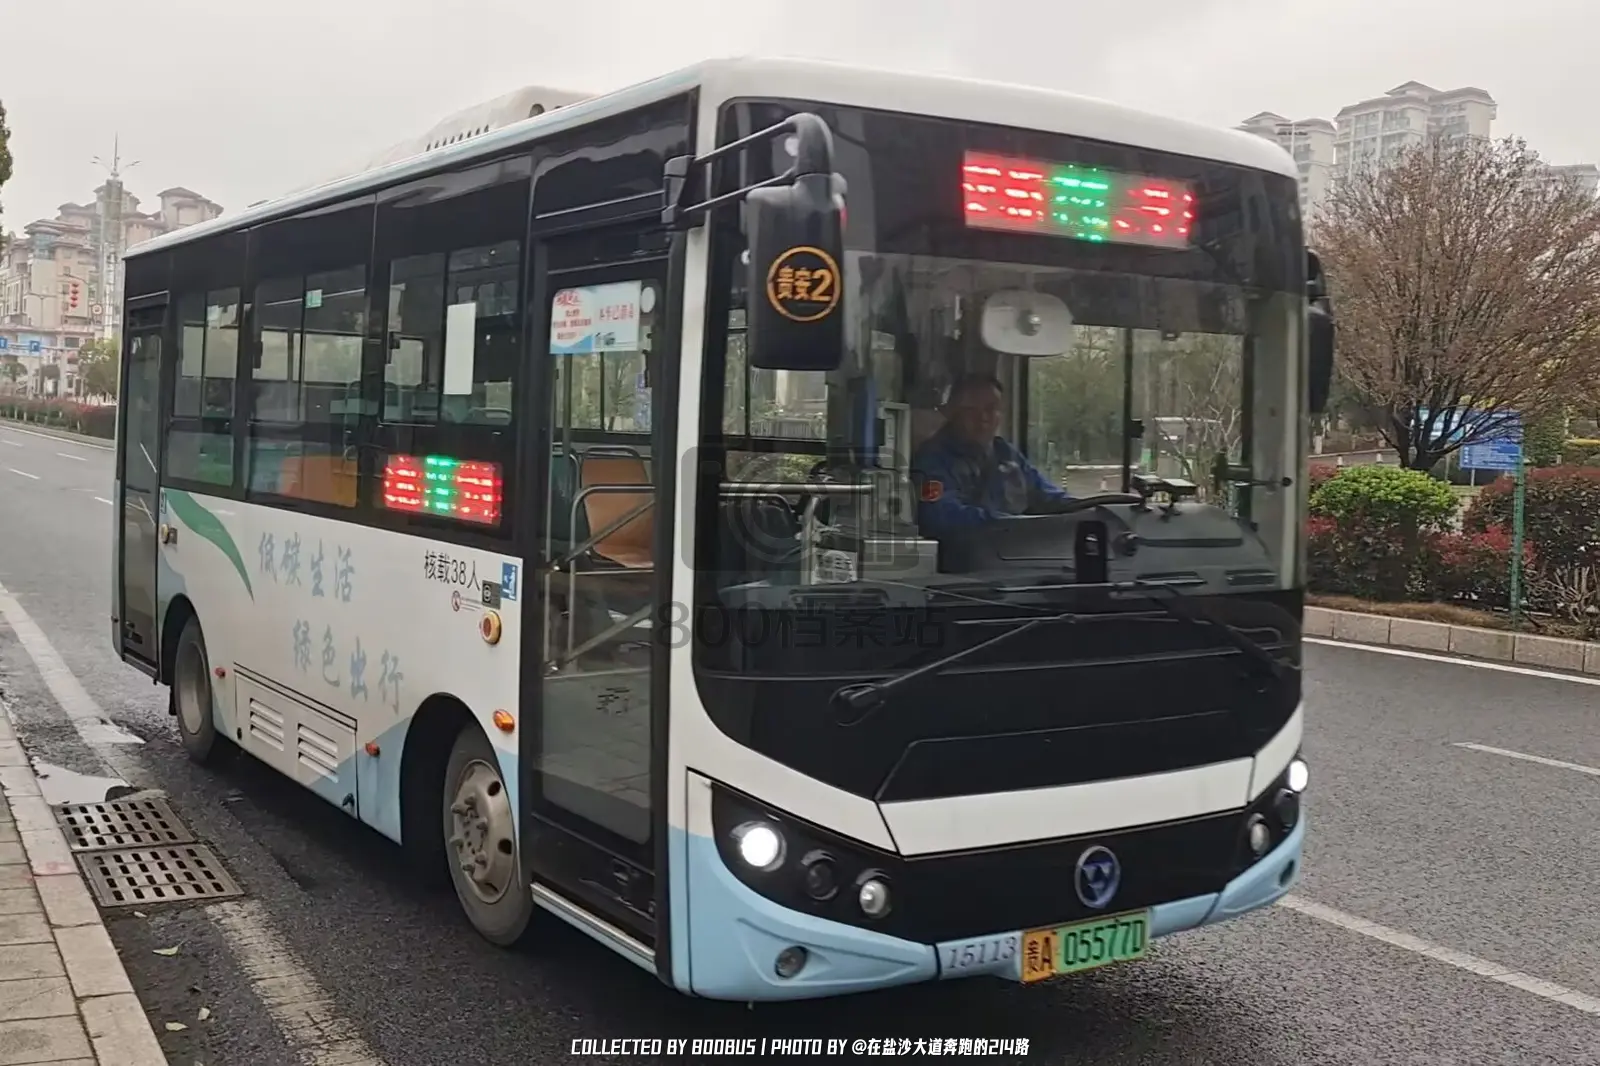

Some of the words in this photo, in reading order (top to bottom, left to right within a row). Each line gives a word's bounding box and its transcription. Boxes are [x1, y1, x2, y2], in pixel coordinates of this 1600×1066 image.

[258, 532, 354, 602] 低碳生活
[424, 550, 481, 591] 核载38人
[293, 619, 403, 715] 绿色出行
[949, 936, 1017, 969] 15113
